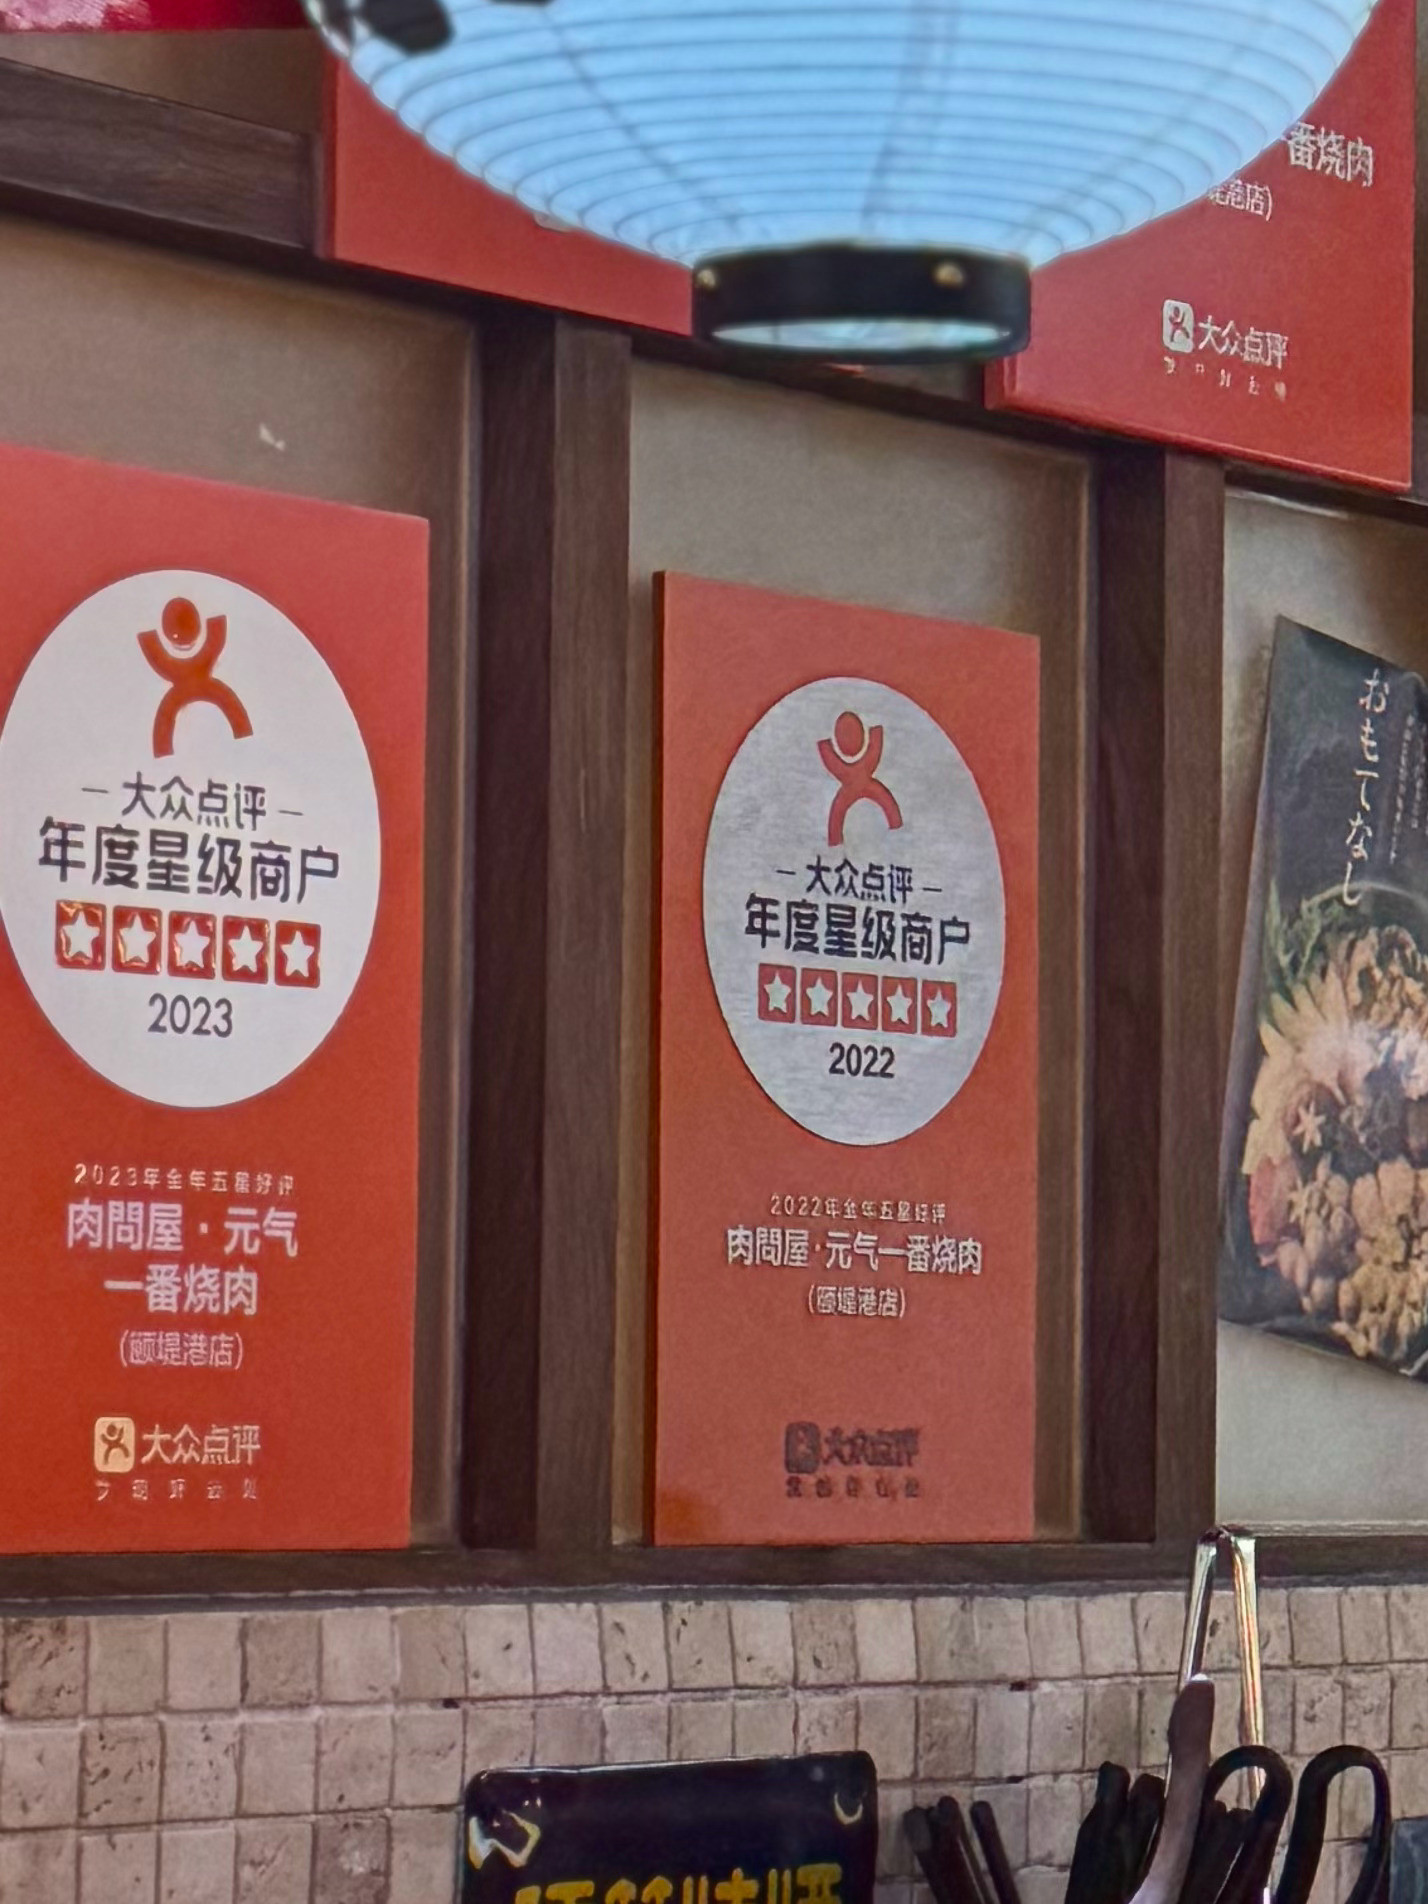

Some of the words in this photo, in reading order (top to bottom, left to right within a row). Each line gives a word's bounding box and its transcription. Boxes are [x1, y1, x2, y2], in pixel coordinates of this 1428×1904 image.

[1284, 120, 1374, 188] 番烧肉
[1198, 314, 1289, 370] 大众点评
[121, 771, 268, 831] 大众点评
[1341, 668, 1391, 907] おもてなし
[37, 814, 340, 905] 年度星级商户
[804, 853, 914, 902] 大众点评
[742, 891, 972, 967] 年度星级商户
[148, 991, 235, 1040] 2023
[828, 1041, 896, 1080] 2022
[74, 1163, 294, 1196] 2023年全年五星好评
[770, 1192, 947, 1225] 2022年全年五星好评
[104, 1263, 258, 1316] 一番烧肉
[141, 1422, 261, 1465] 大众点评
